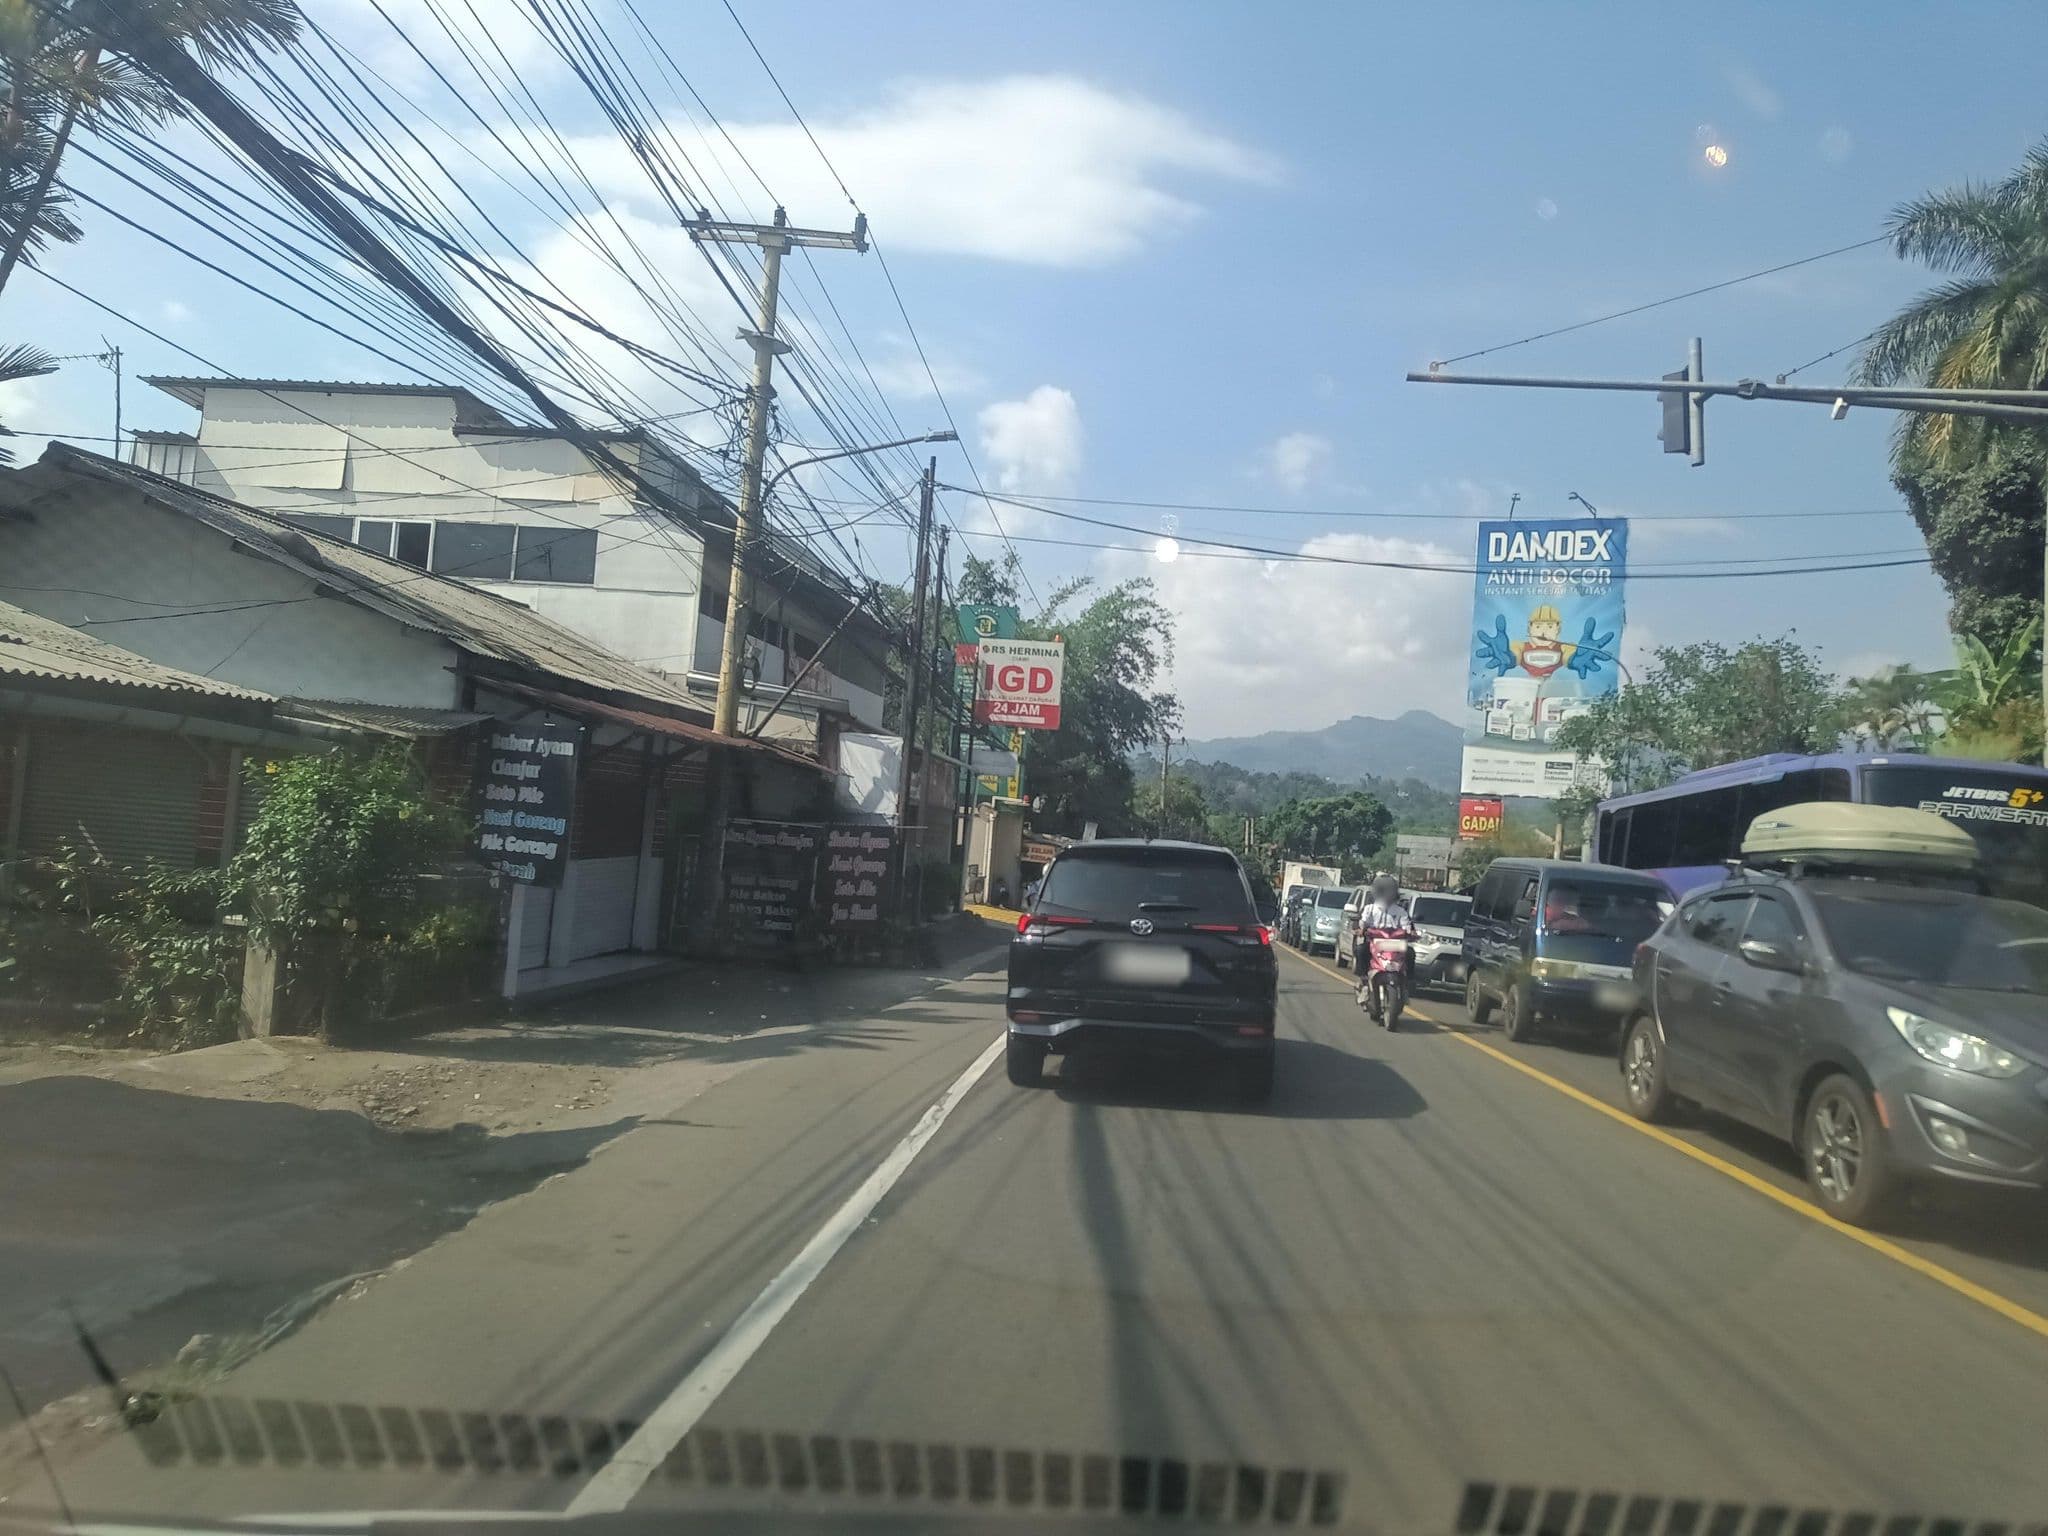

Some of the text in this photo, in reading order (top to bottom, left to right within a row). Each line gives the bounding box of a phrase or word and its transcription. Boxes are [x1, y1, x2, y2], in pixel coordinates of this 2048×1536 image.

[1488, 529, 1613, 563] DAMDEX
[1487, 567, 1611, 585] ANTI BOCOR
[1484, 587, 1523, 596] INSTANT
[992, 645, 1060, 658] RS HERMINA
[985, 664, 1054, 694] IGD
[993, 702, 1041, 716] 24 JAM
[492, 734, 575, 757] Bubur Ayam
[491, 759, 541, 780] Cianjur
[486, 783, 516, 801] Soto
[1942, 787, 2010, 801] JETBUS
[484, 809, 566, 835] Nasi Goreng
[1461, 815, 1500, 832] GADAI
[505, 836, 558, 860] Goreng
